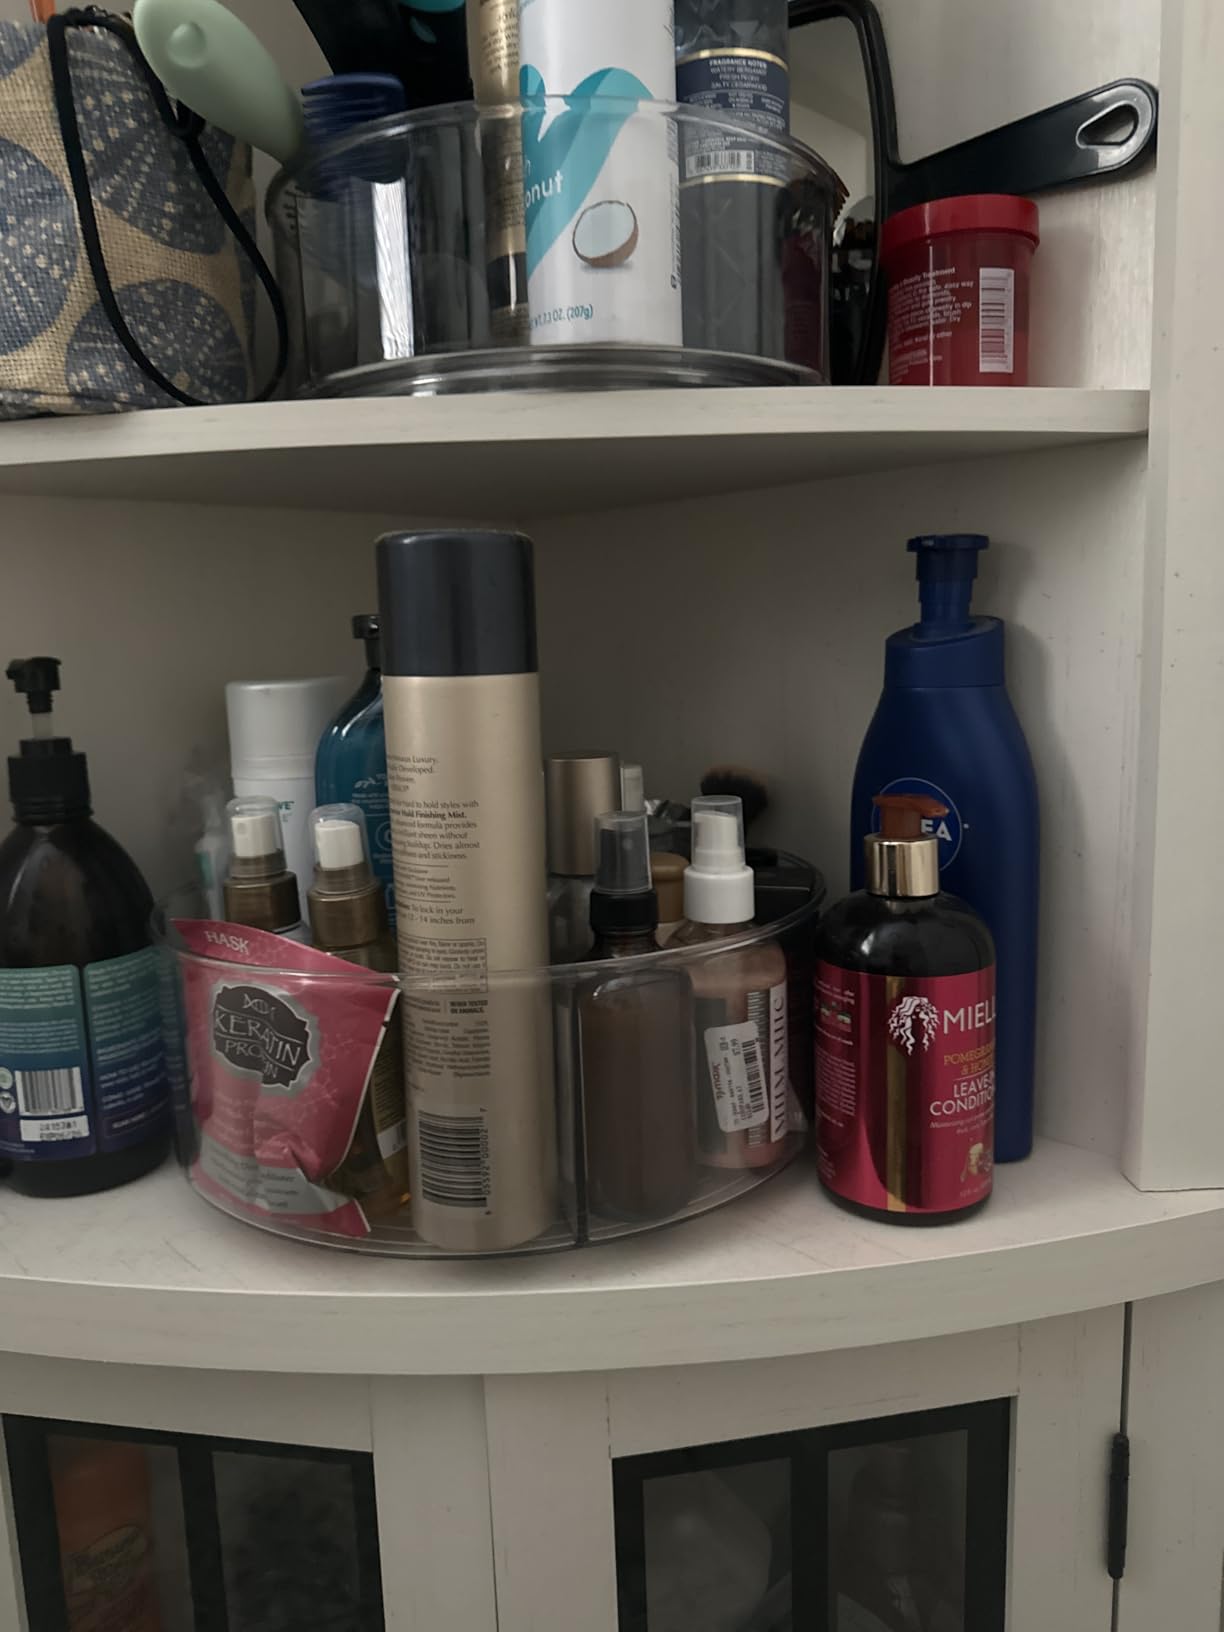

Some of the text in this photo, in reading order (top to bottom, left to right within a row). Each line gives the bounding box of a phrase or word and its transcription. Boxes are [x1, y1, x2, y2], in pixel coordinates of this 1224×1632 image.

[525, 169, 563, 208] onut
[567, 304, 593, 320] (207g)
[423, 800, 439, 808] hold
[415, 811, 446, 820] Finishing
[444, 822, 477, 831] provides
[455, 841, 480, 849] almost
[445, 907, 464, 916] your
[430, 916, 454, 925] inches
[456, 917, 475, 925] from
[204, 929, 249, 955] HASK
[943, 996, 996, 1035] MIELL
[215, 1009, 301, 1066] KERATIN
[225, 1040, 278, 1078] PROIN
[930, 1087, 994, 1116] CONDITIO
